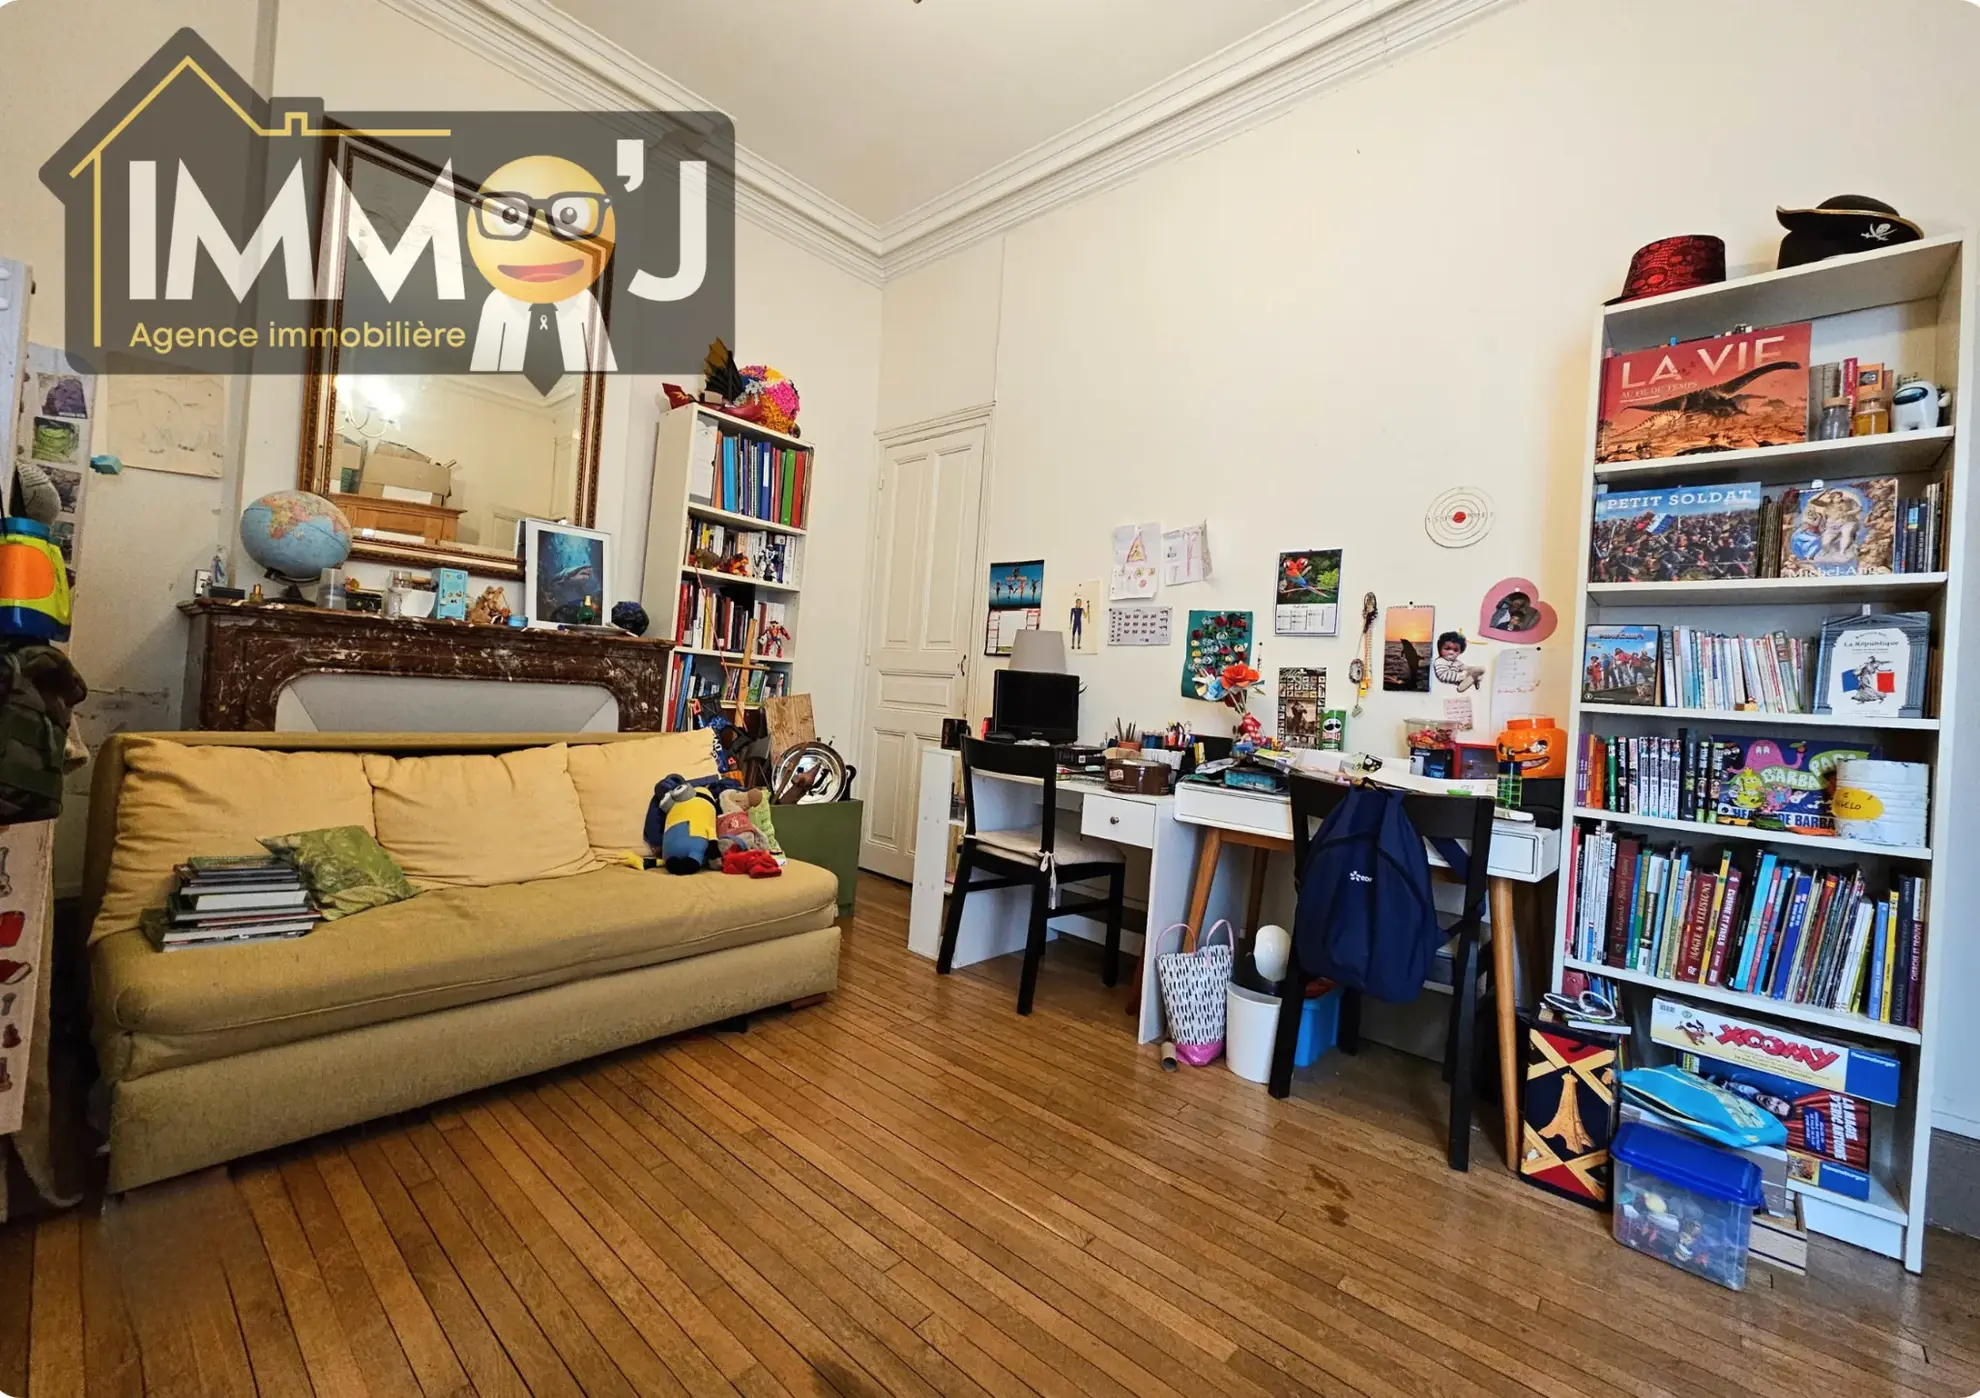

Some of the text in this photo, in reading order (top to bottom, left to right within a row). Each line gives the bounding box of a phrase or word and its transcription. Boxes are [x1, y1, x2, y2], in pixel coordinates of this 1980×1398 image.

[1621, 335, 1785, 389] LA VIE
[1607, 489, 1751, 510] PETIT SOLDAT
[1760, 766, 1822, 789] BARBA
[1693, 881, 1712, 925] ILLUSIONS
[1690, 932, 1703, 961] MAGIE
[1913, 923, 1921, 947] TROUVE
[1910, 955, 1919, 981] CHERCHE
[1714, 1023, 1841, 1072] XOOMY
[1829, 1093, 1848, 1161] D'ERIC ANTOINE
[1842, 1097, 1859, 1141] LA MAGIE
